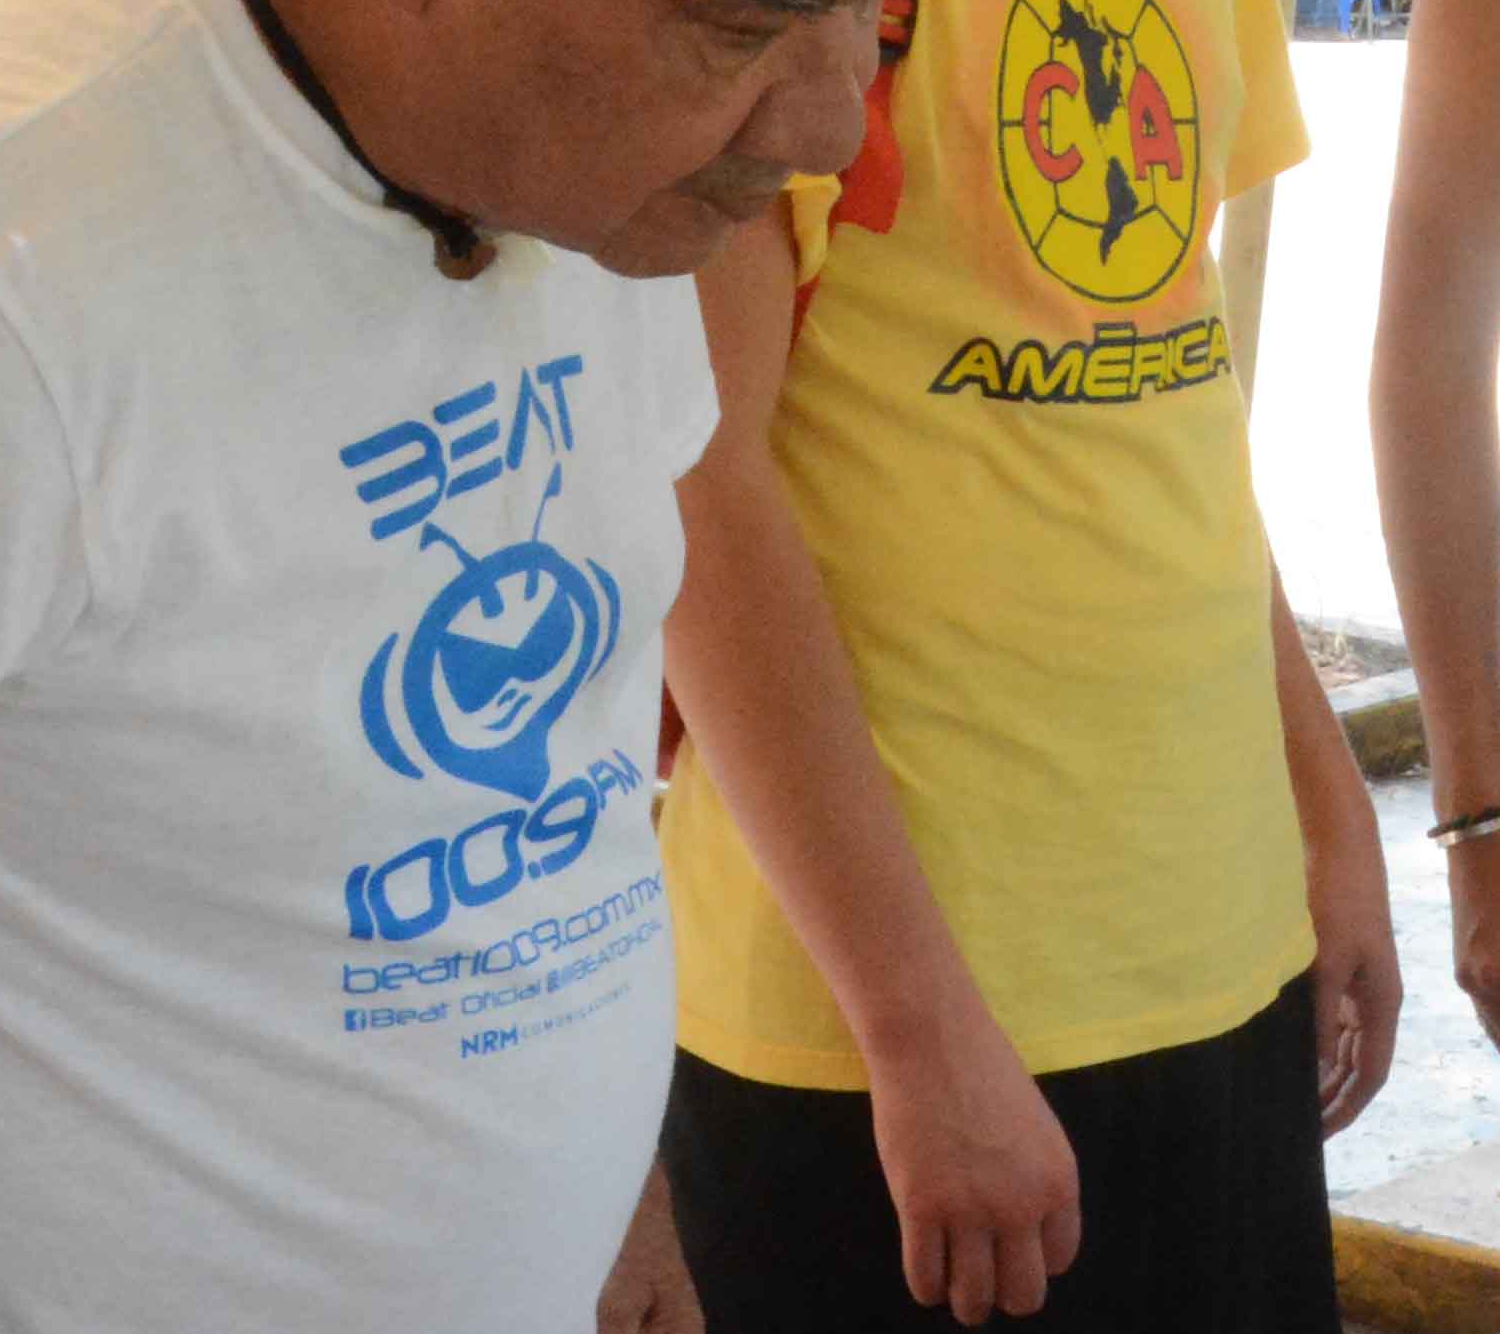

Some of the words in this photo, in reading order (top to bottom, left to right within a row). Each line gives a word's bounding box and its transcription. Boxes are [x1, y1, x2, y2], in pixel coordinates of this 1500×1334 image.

[339, 353, 583, 541] BEAT
[345, 776, 599, 941] 100.9
[460, 1023, 519, 1059] NRM
